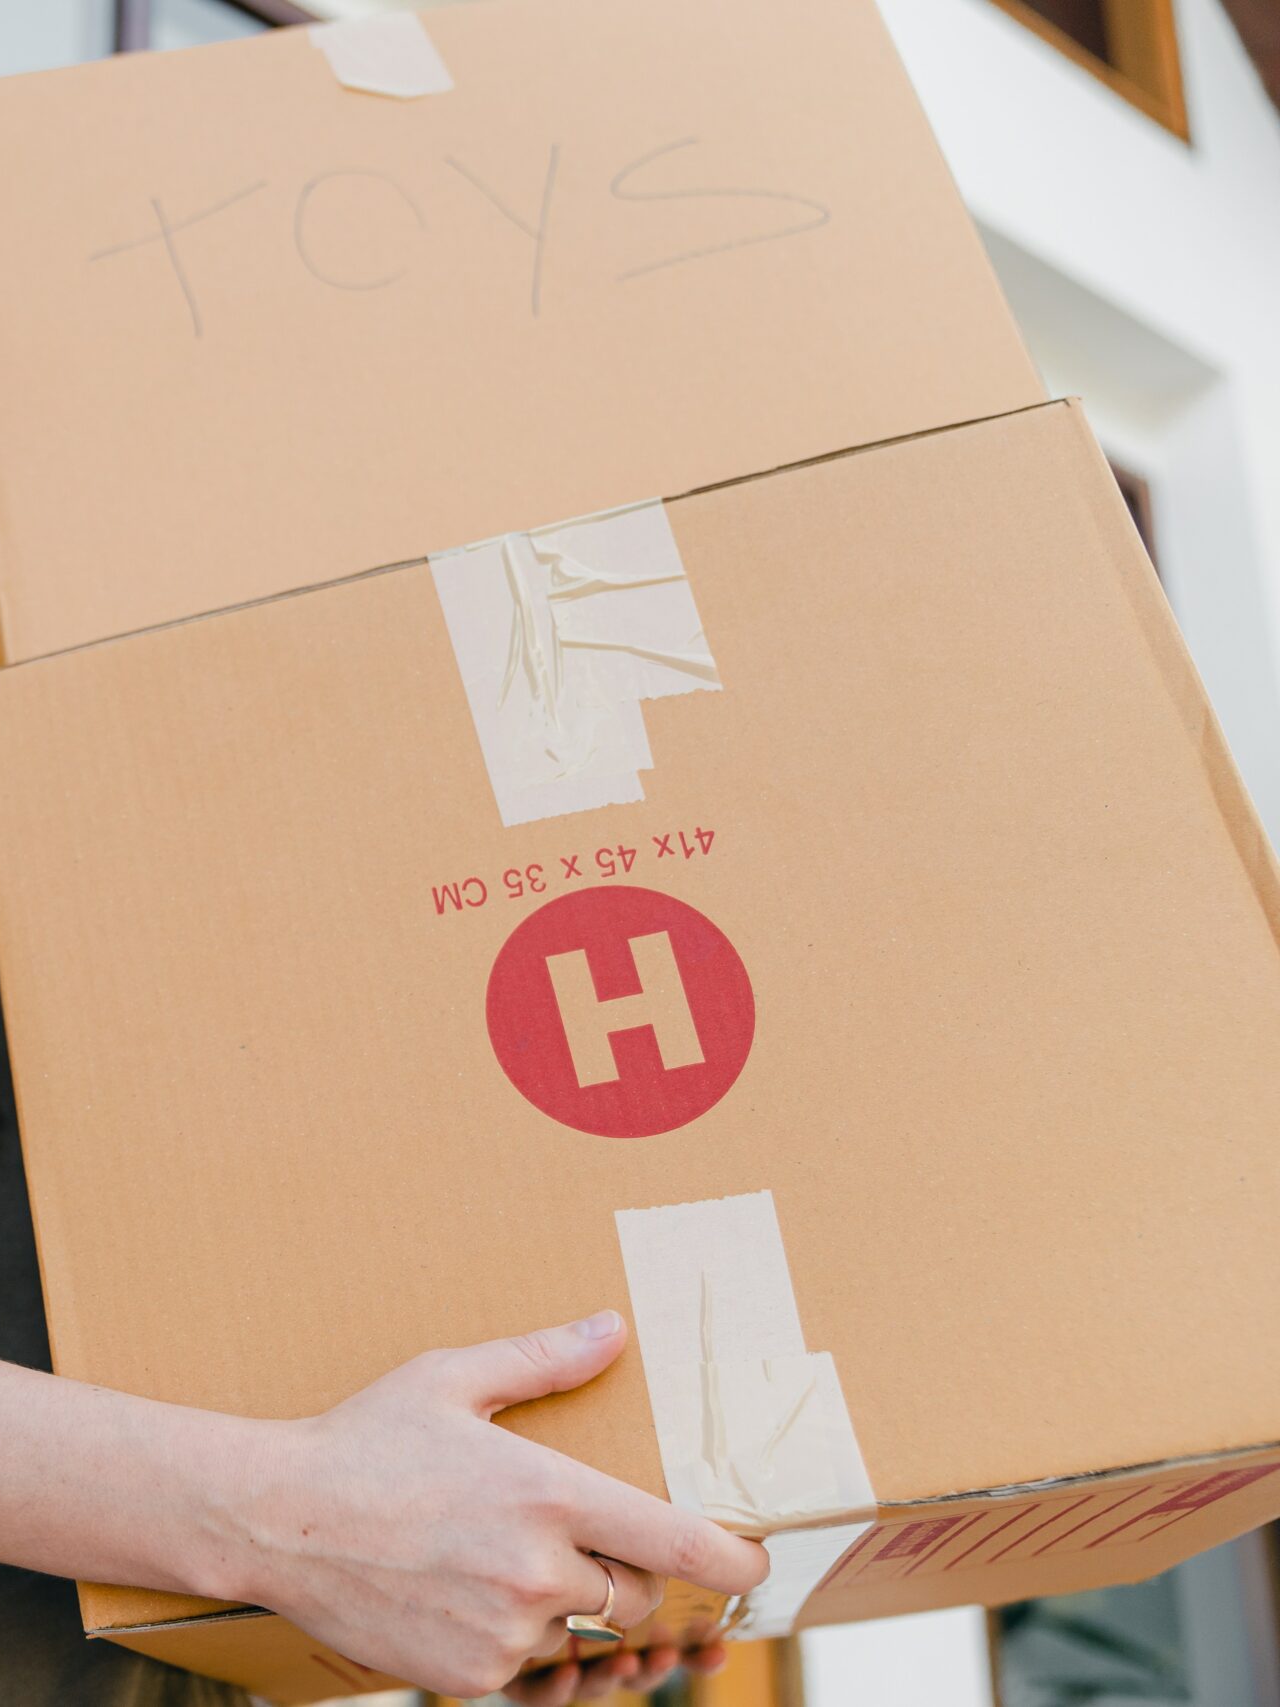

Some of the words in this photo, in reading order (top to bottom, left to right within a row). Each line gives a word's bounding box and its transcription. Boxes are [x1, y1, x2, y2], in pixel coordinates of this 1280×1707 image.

[593, 844, 638, 878] 45
[431, 876, 489, 916] CM
[501, 863, 547, 899] 35
[545, 930, 706, 1089] H
